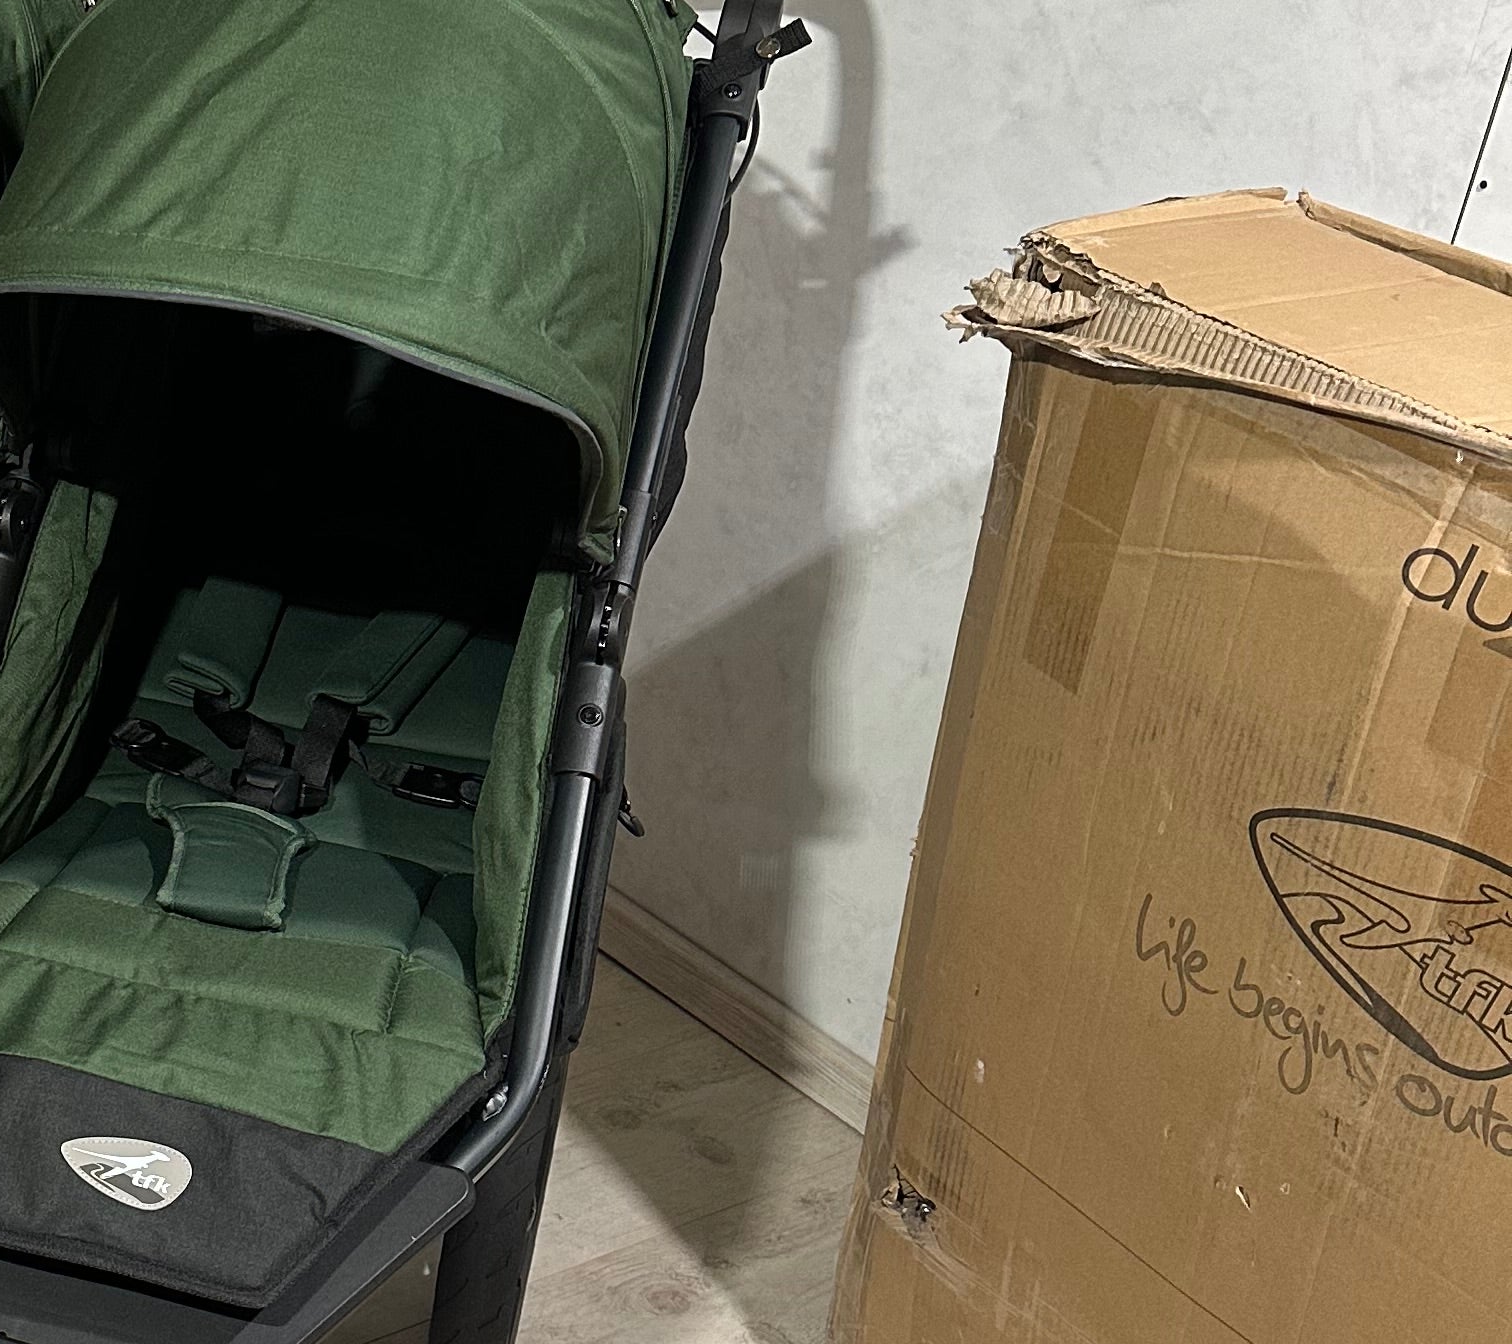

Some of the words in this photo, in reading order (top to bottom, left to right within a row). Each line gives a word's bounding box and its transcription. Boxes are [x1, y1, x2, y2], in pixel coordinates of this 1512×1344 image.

[1136, 892, 1219, 1016] Life
[1229, 957, 1380, 1095] begins
[131, 1170, 171, 1194] tfk
